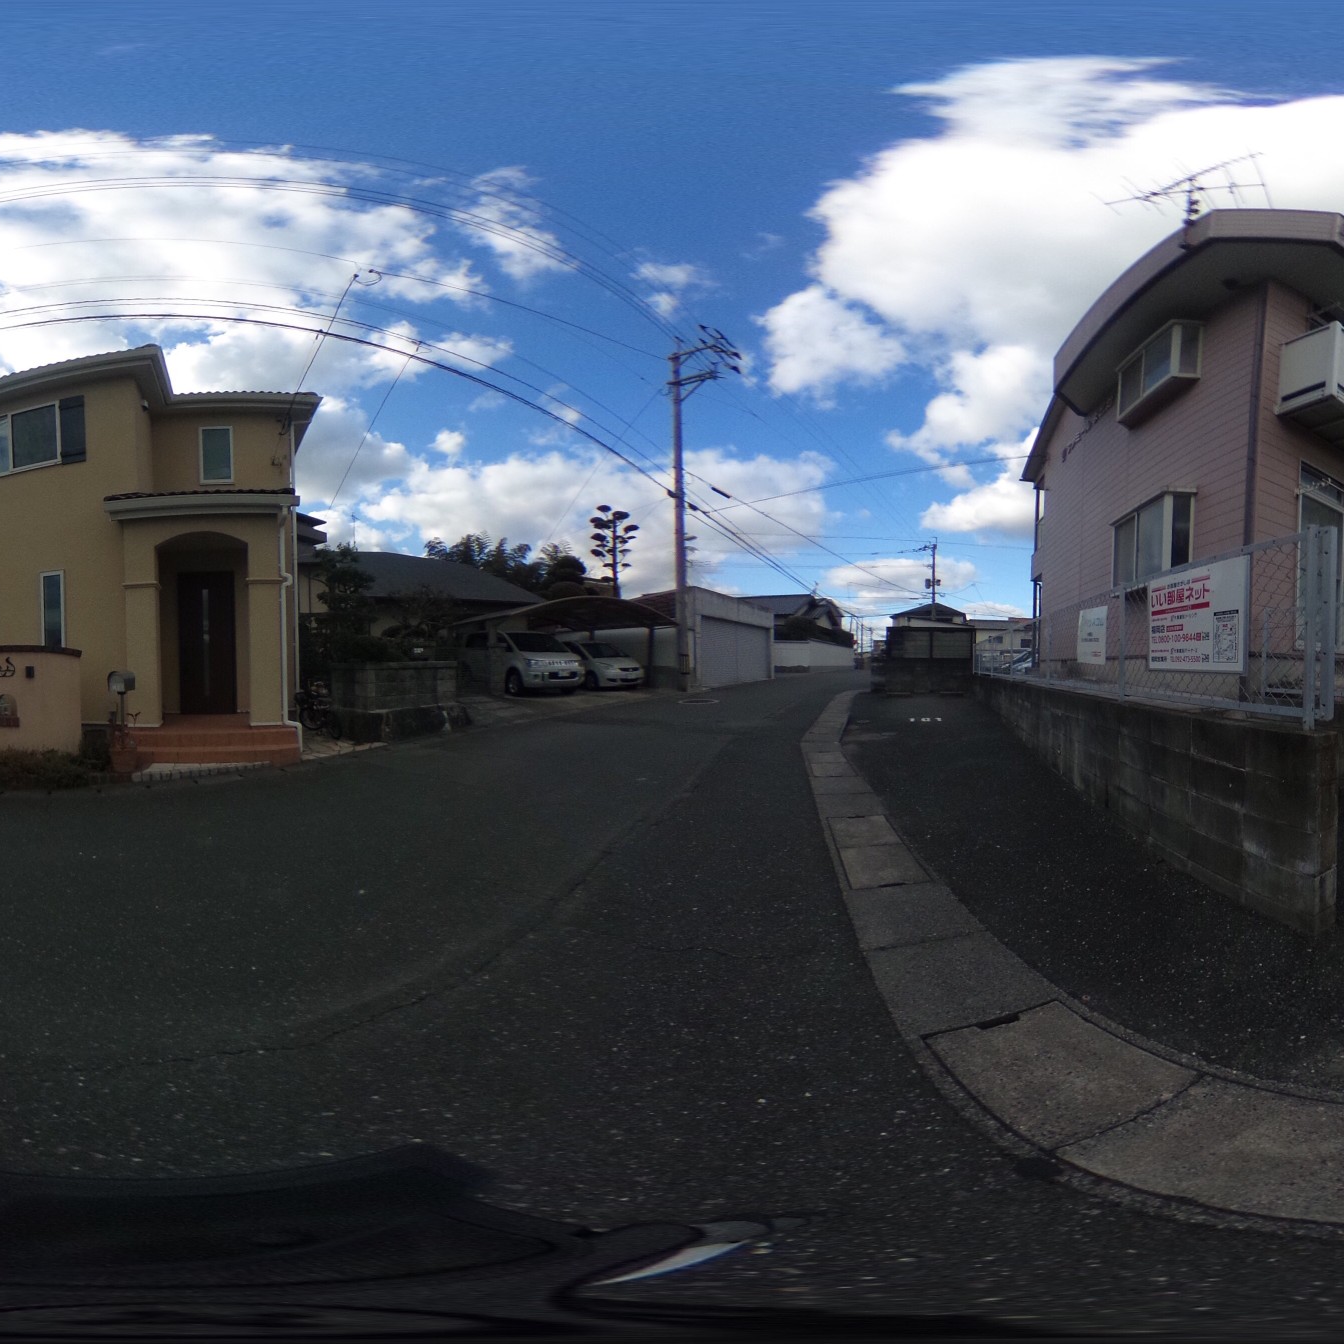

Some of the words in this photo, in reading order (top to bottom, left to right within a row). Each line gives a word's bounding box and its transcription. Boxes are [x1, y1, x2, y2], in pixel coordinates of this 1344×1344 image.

[1151, 583, 1210, 608] いい部屋ネット
